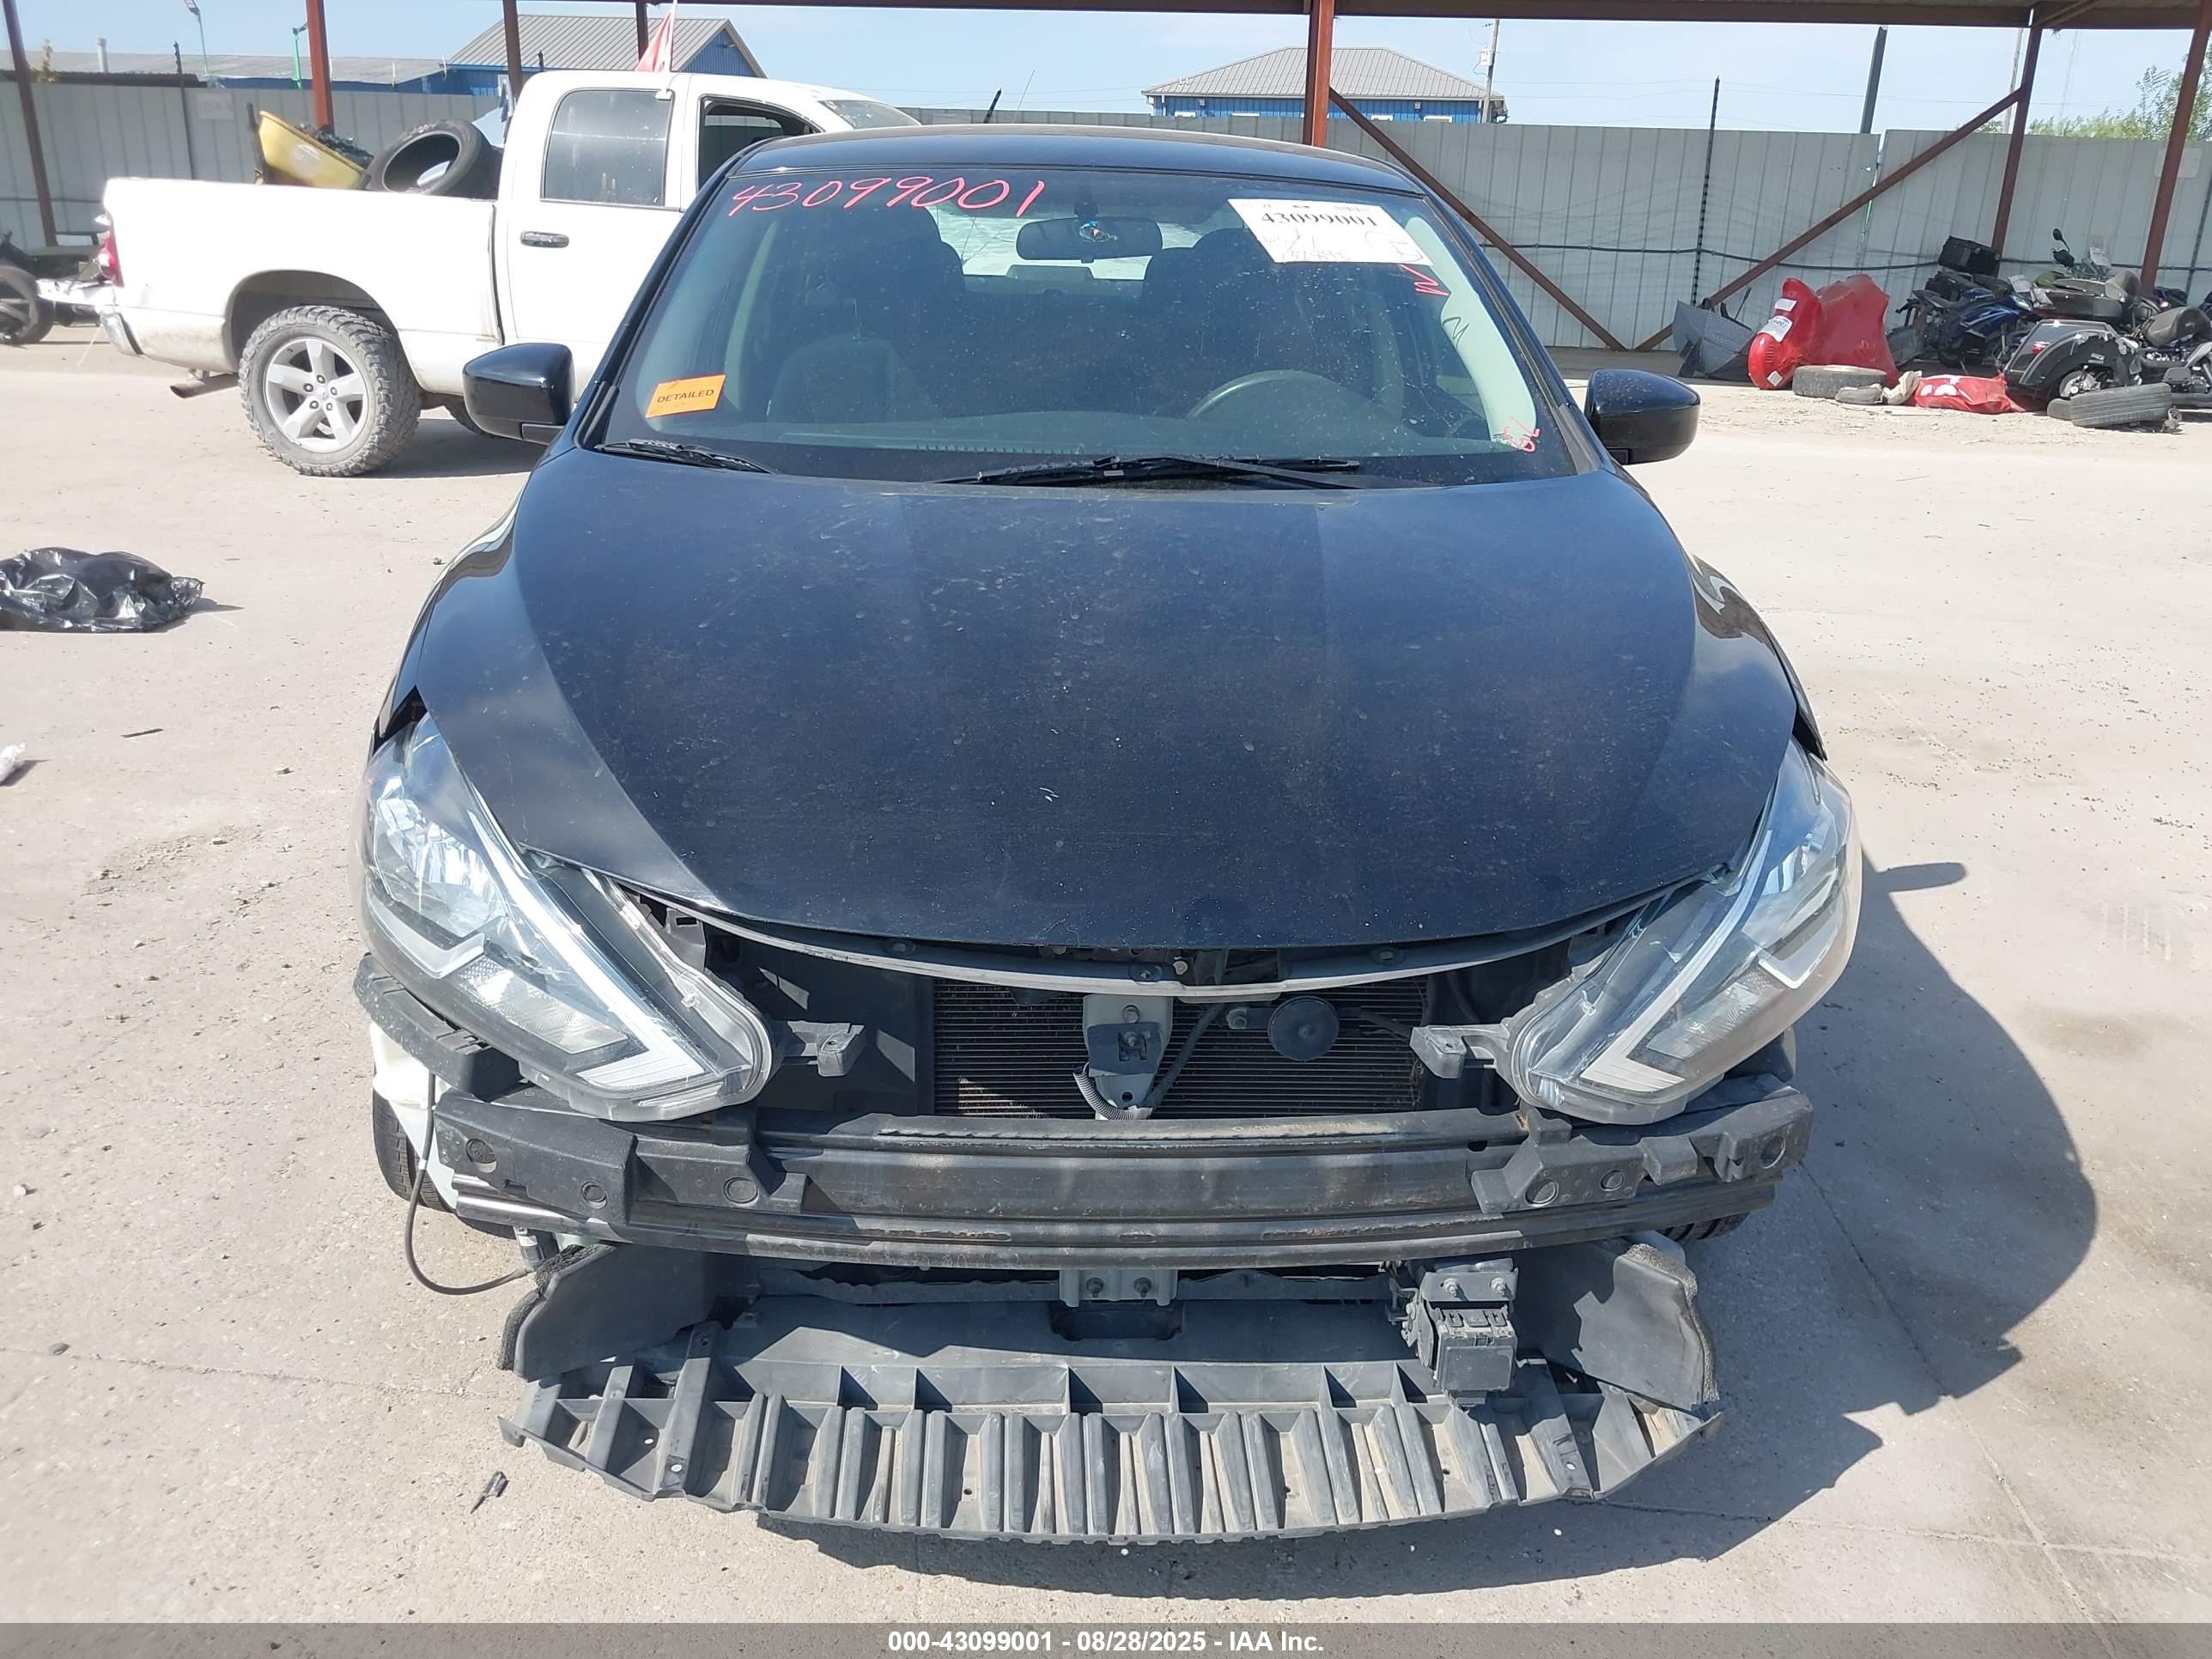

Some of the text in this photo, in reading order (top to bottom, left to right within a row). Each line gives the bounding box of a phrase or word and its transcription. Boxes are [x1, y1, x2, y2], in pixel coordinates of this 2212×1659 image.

[727, 175, 1045, 217] 43099001
[1261, 212, 1379, 227] 43099001
[657, 389, 714, 403] DETAILED
